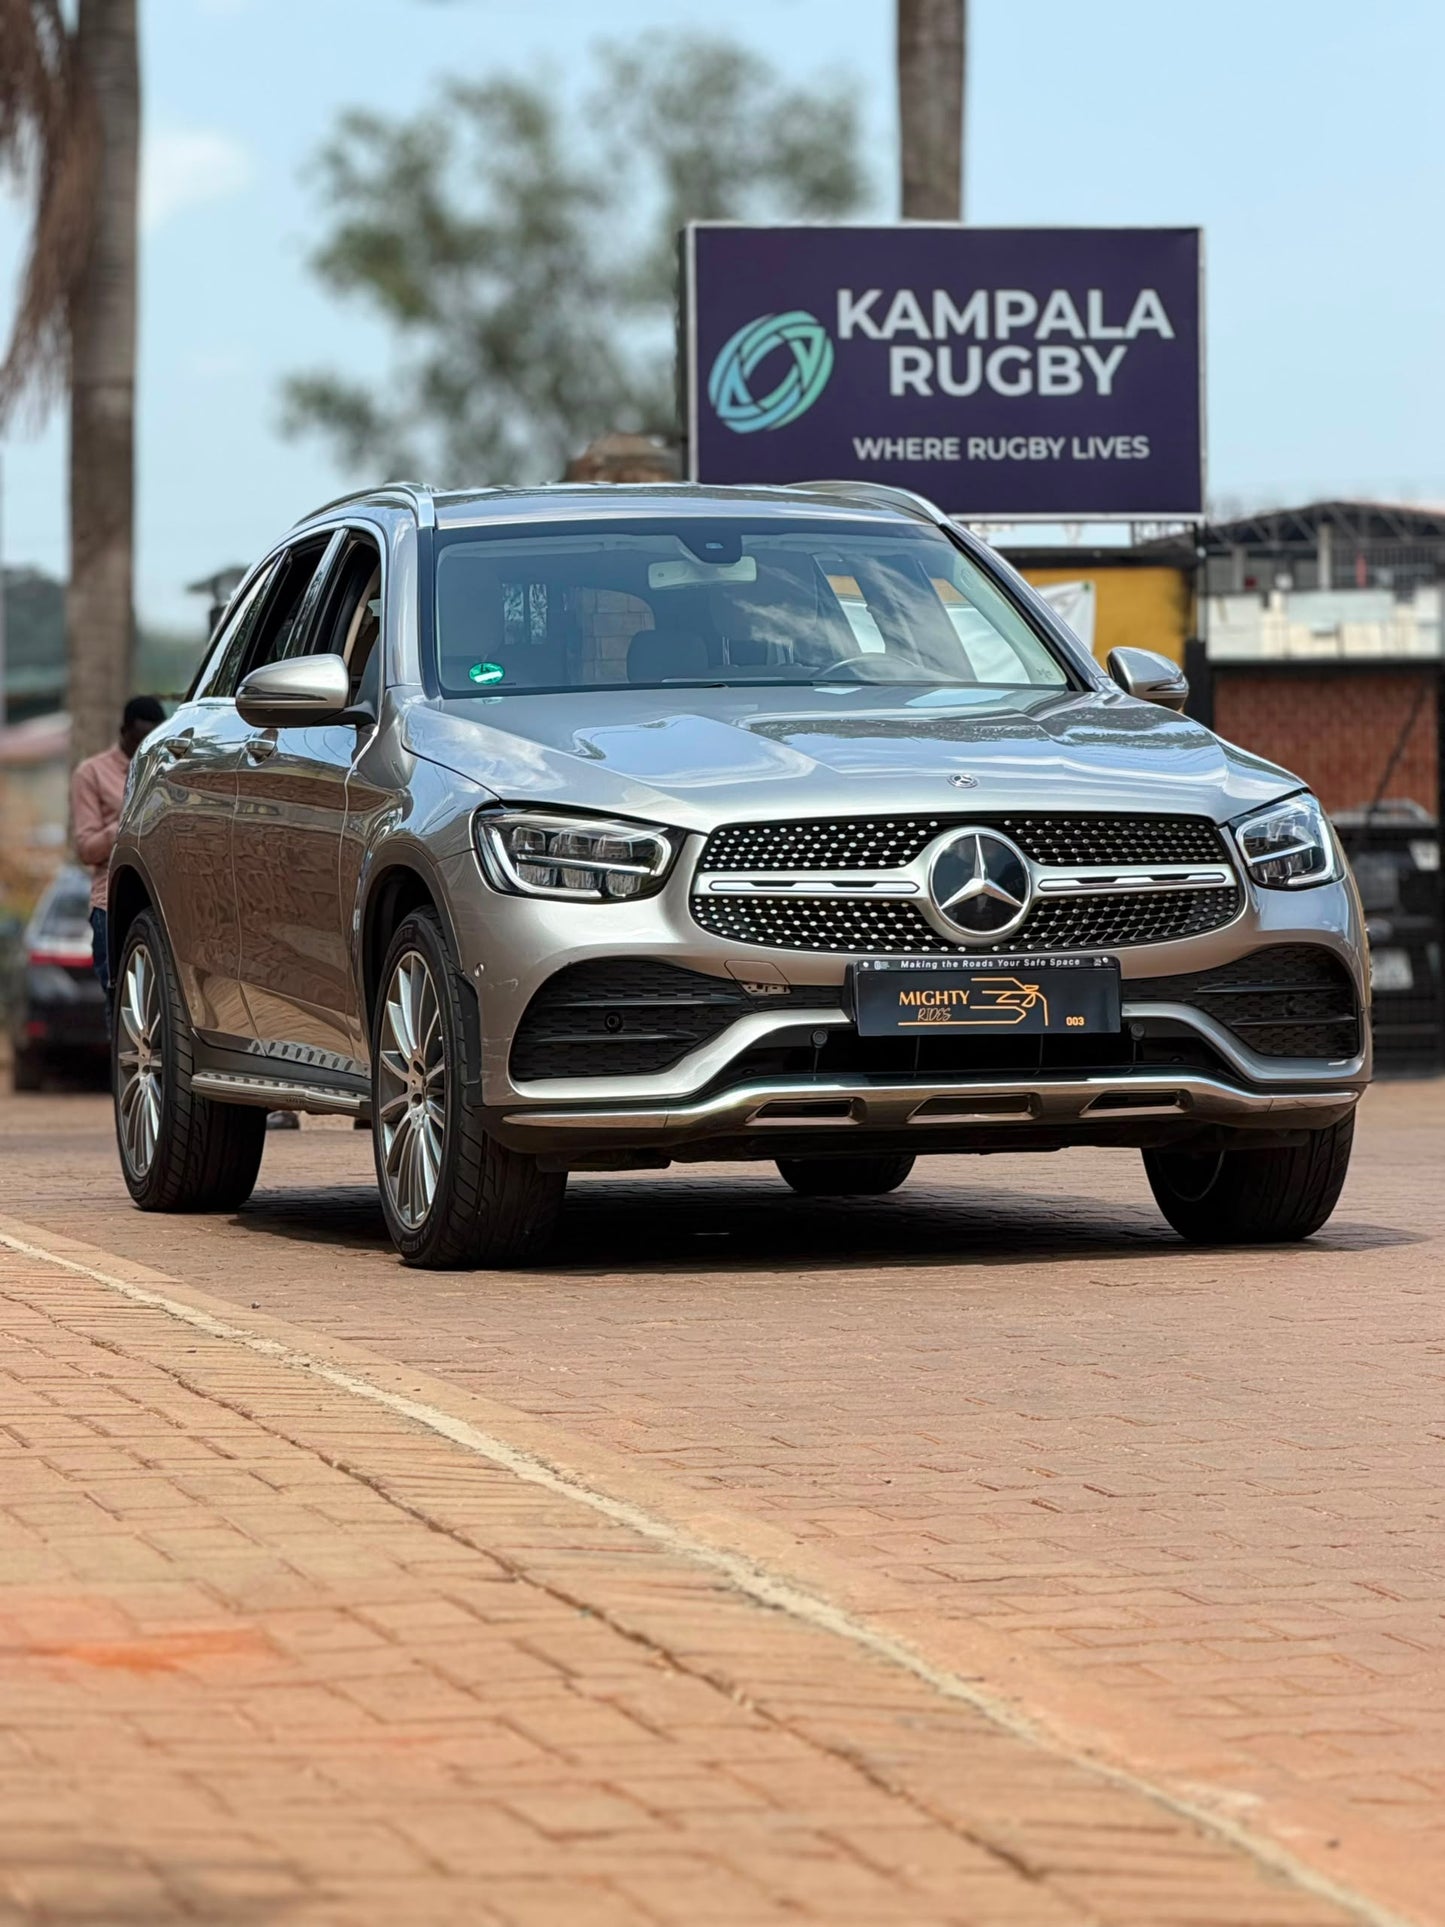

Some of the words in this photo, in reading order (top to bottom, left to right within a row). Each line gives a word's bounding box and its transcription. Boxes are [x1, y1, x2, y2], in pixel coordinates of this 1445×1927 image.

[836, 288, 1175, 340] KAMPALA
[889, 345, 1127, 397] RUGBY
[852, 437, 961, 461] WHERE
[967, 436, 1066, 461] RUGBY
[1072, 435, 1150, 460] LIVES
[900, 960, 938, 970] Making
[941, 960, 959, 969] the
[962, 959, 993, 968] Roads
[997, 959, 1021, 968] Your
[1023, 958, 1046, 967] Safe
[1049, 958, 1081, 968] Space
[899, 990, 970, 1006] MIGHTY
[1065, 1016, 1085, 1026] 003
